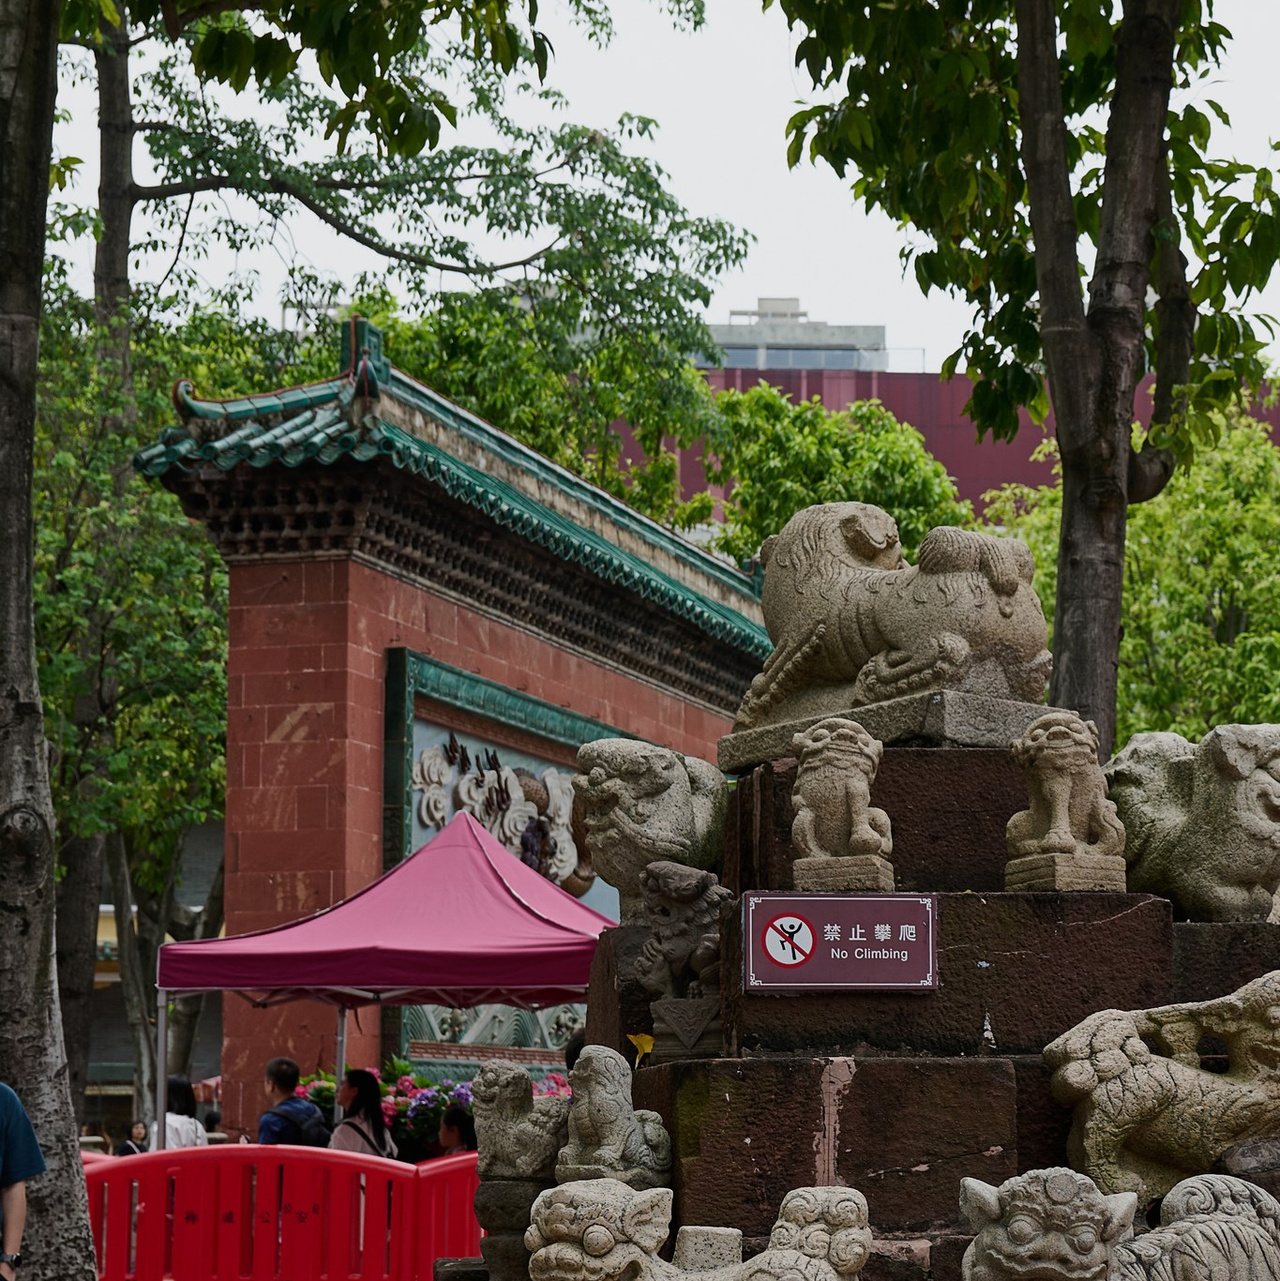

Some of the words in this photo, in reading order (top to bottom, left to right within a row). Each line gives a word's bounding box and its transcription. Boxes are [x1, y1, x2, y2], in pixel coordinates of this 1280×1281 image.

[823, 923, 917, 942] 禁止攀爬
[831, 947, 849, 959] No
[854, 947, 909, 962] Climbing
